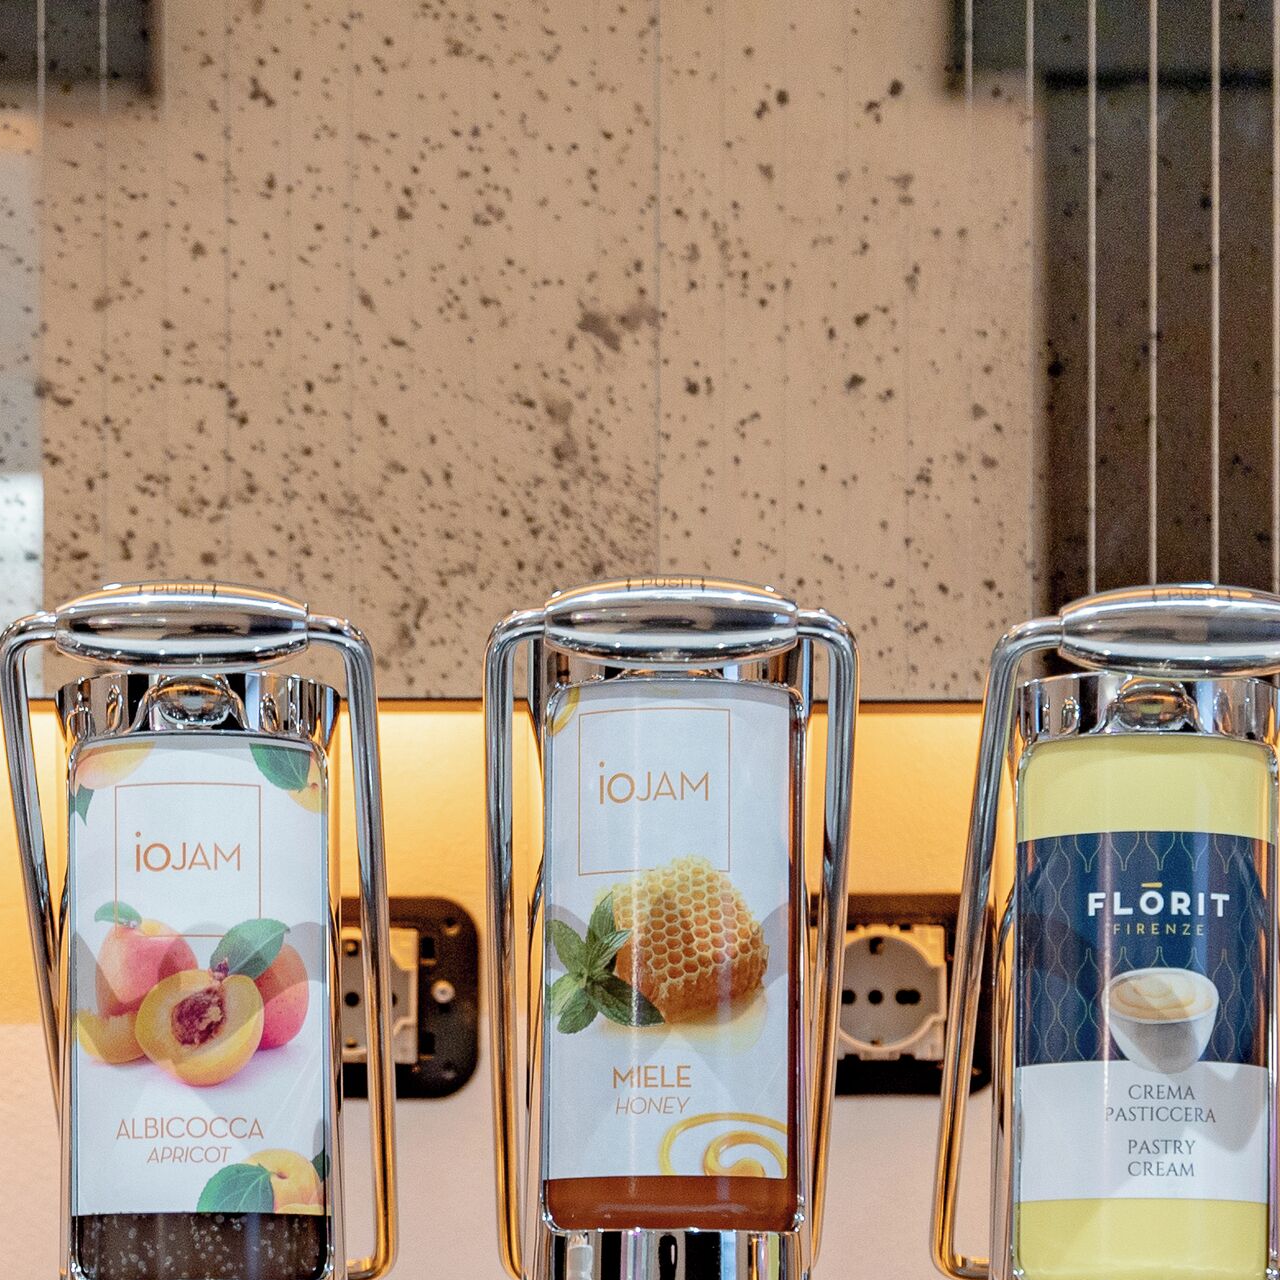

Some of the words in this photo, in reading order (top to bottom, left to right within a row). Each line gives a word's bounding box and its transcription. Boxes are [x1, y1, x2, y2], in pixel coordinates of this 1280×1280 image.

[153, 584, 205, 595] PUSH
[641, 578, 693, 588] PUSH
[1167, 589, 1219, 600] PUSH
[1113, 922, 1205, 936] FIRENZE
[613, 1065, 692, 1090] MIELE
[1128, 1084, 1196, 1101] CREMA
[615, 1096, 691, 1116] HONEY
[1105, 1106, 1217, 1124] PASTICCERA
[116, 1117, 265, 1141] ALBICOCCA
[146, 1145, 232, 1165] APRICOT
[1127, 1138, 1196, 1156] PASTRY
[1127, 1160, 1196, 1178] CREAM
